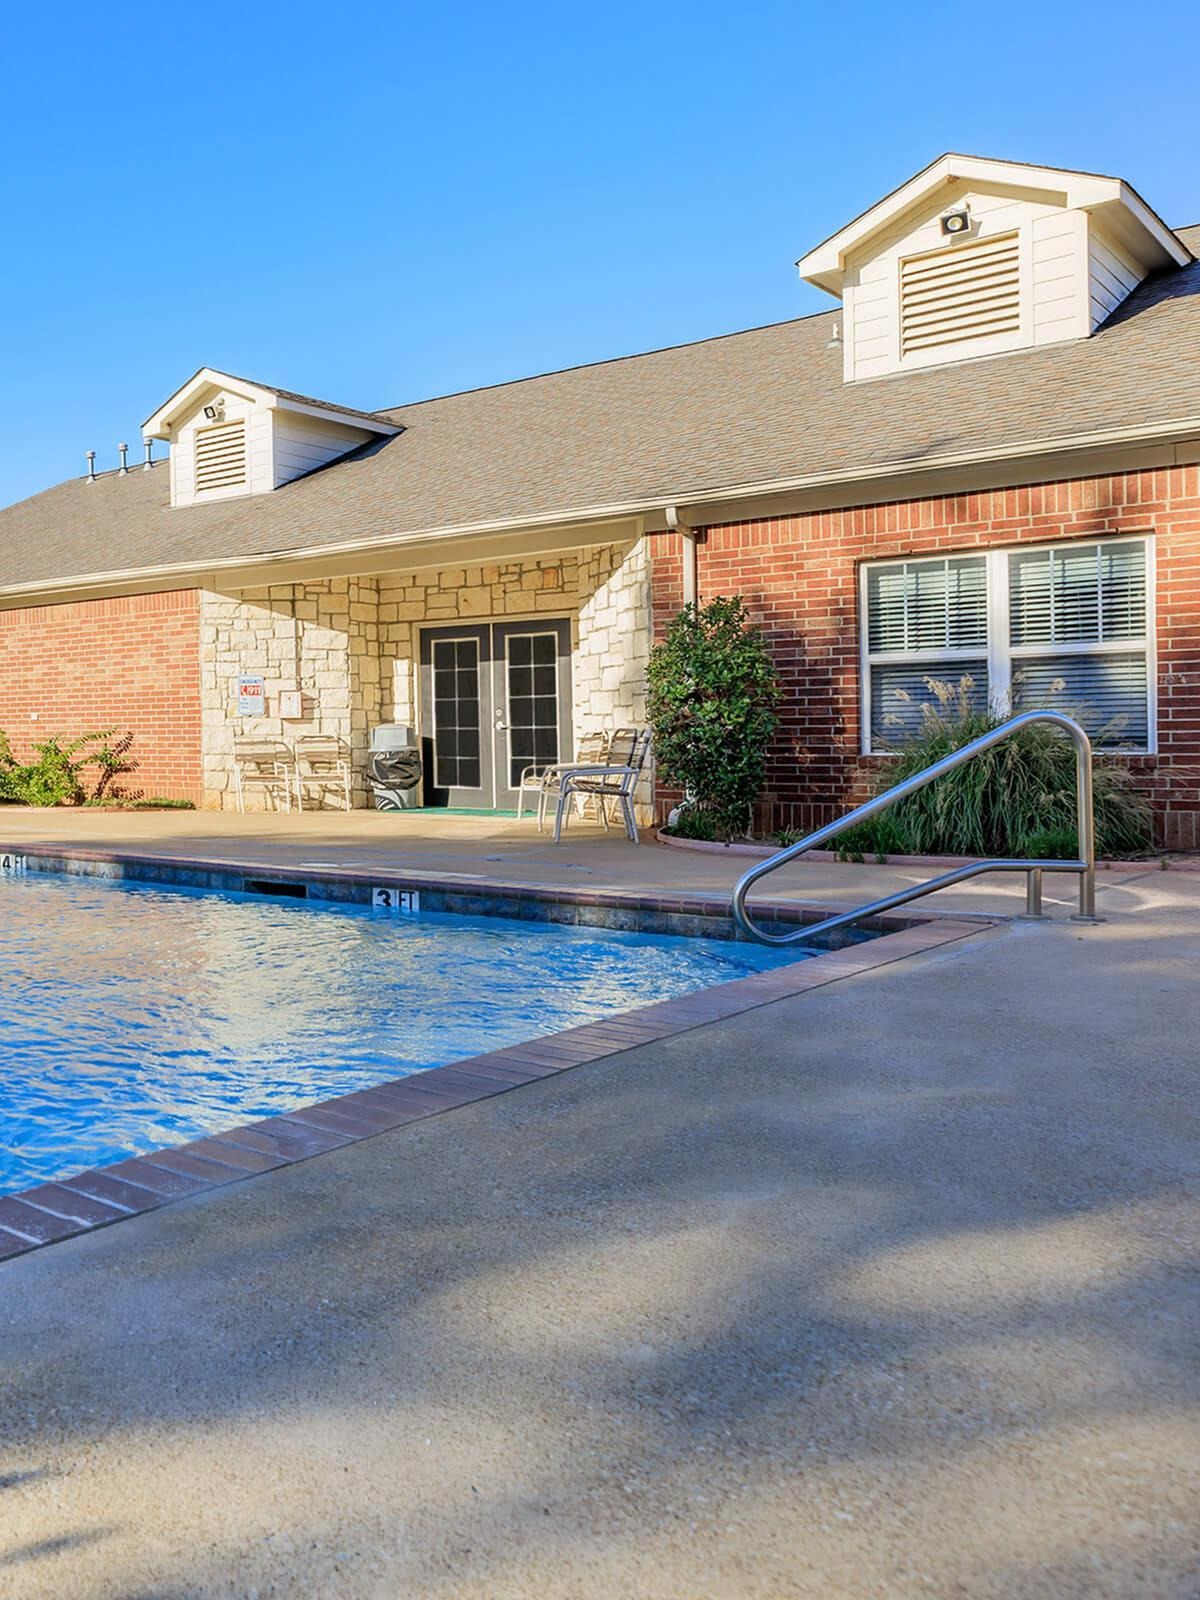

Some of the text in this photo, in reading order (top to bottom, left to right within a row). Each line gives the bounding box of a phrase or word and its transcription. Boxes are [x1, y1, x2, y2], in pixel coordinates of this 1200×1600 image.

[248, 686, 261, 695] 911
[2, 855, 11, 868] 4
[376, 889, 415, 912] 3 FT
